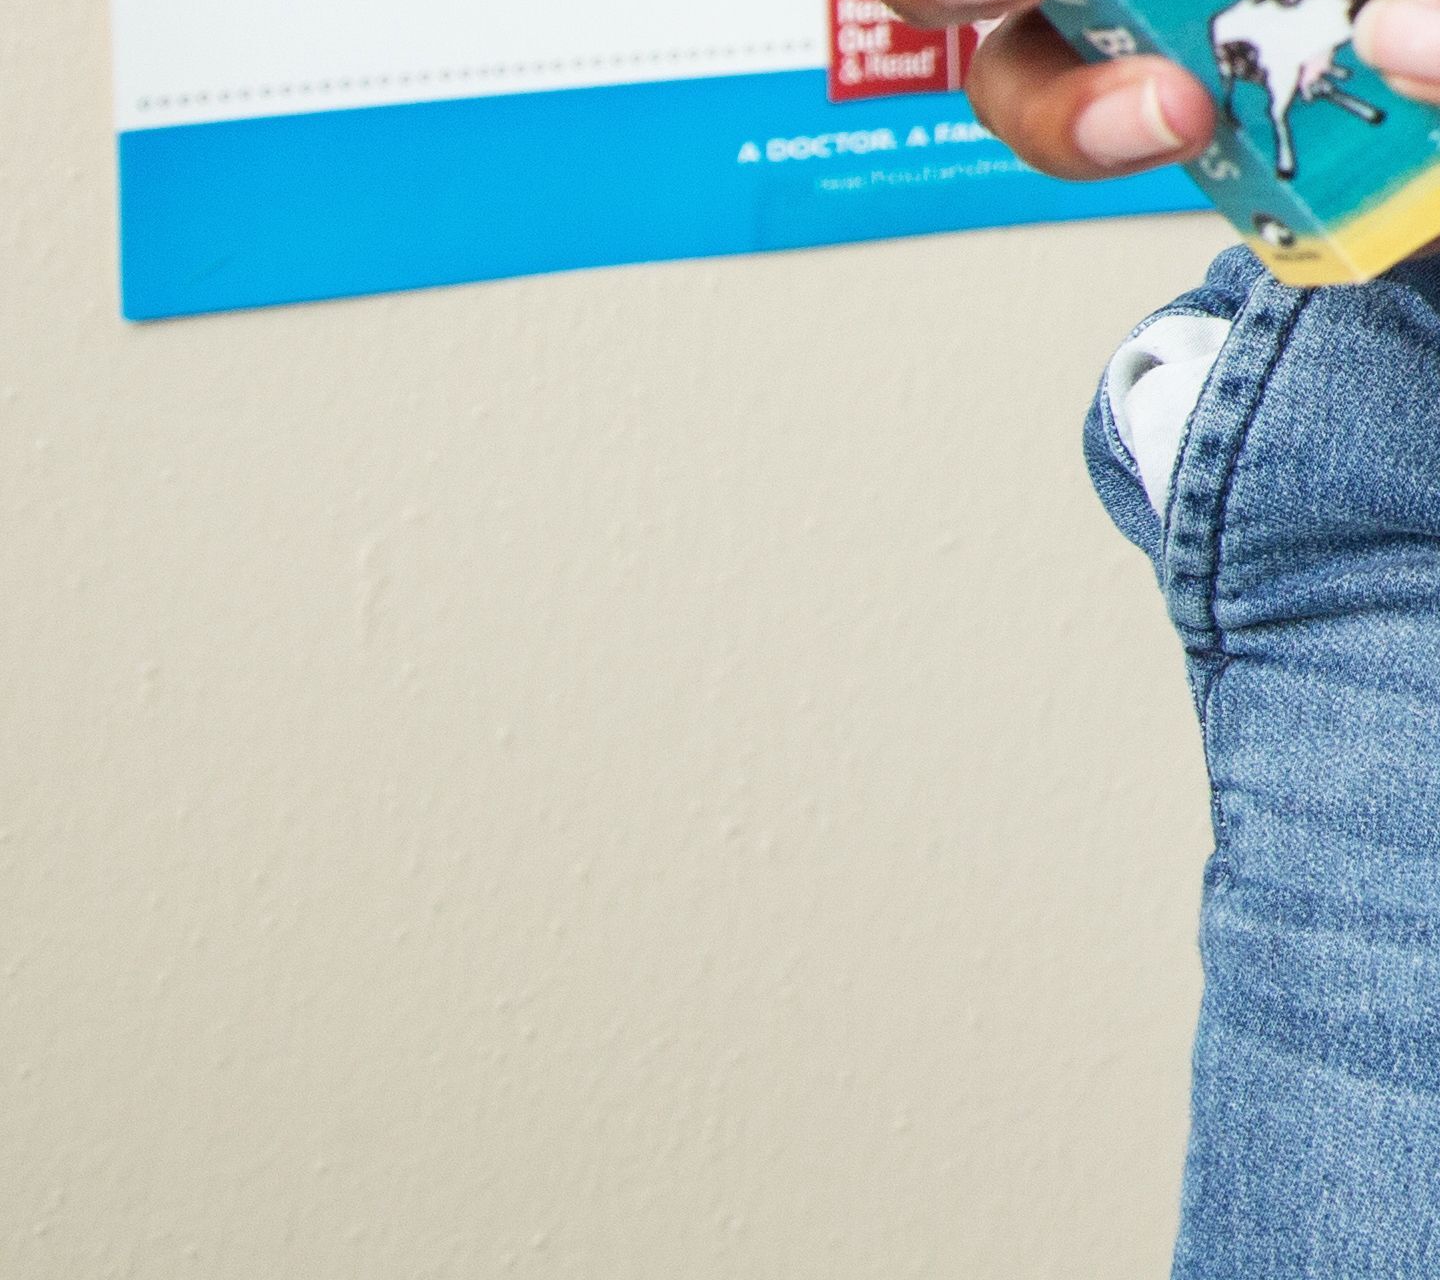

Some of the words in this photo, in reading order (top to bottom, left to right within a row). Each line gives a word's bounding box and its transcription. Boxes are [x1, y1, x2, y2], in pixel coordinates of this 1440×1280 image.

[838, 23, 890, 54] Out
[864, 45, 936, 80] Read
[737, 140, 761, 163] A
[905, 125, 929, 148] A
